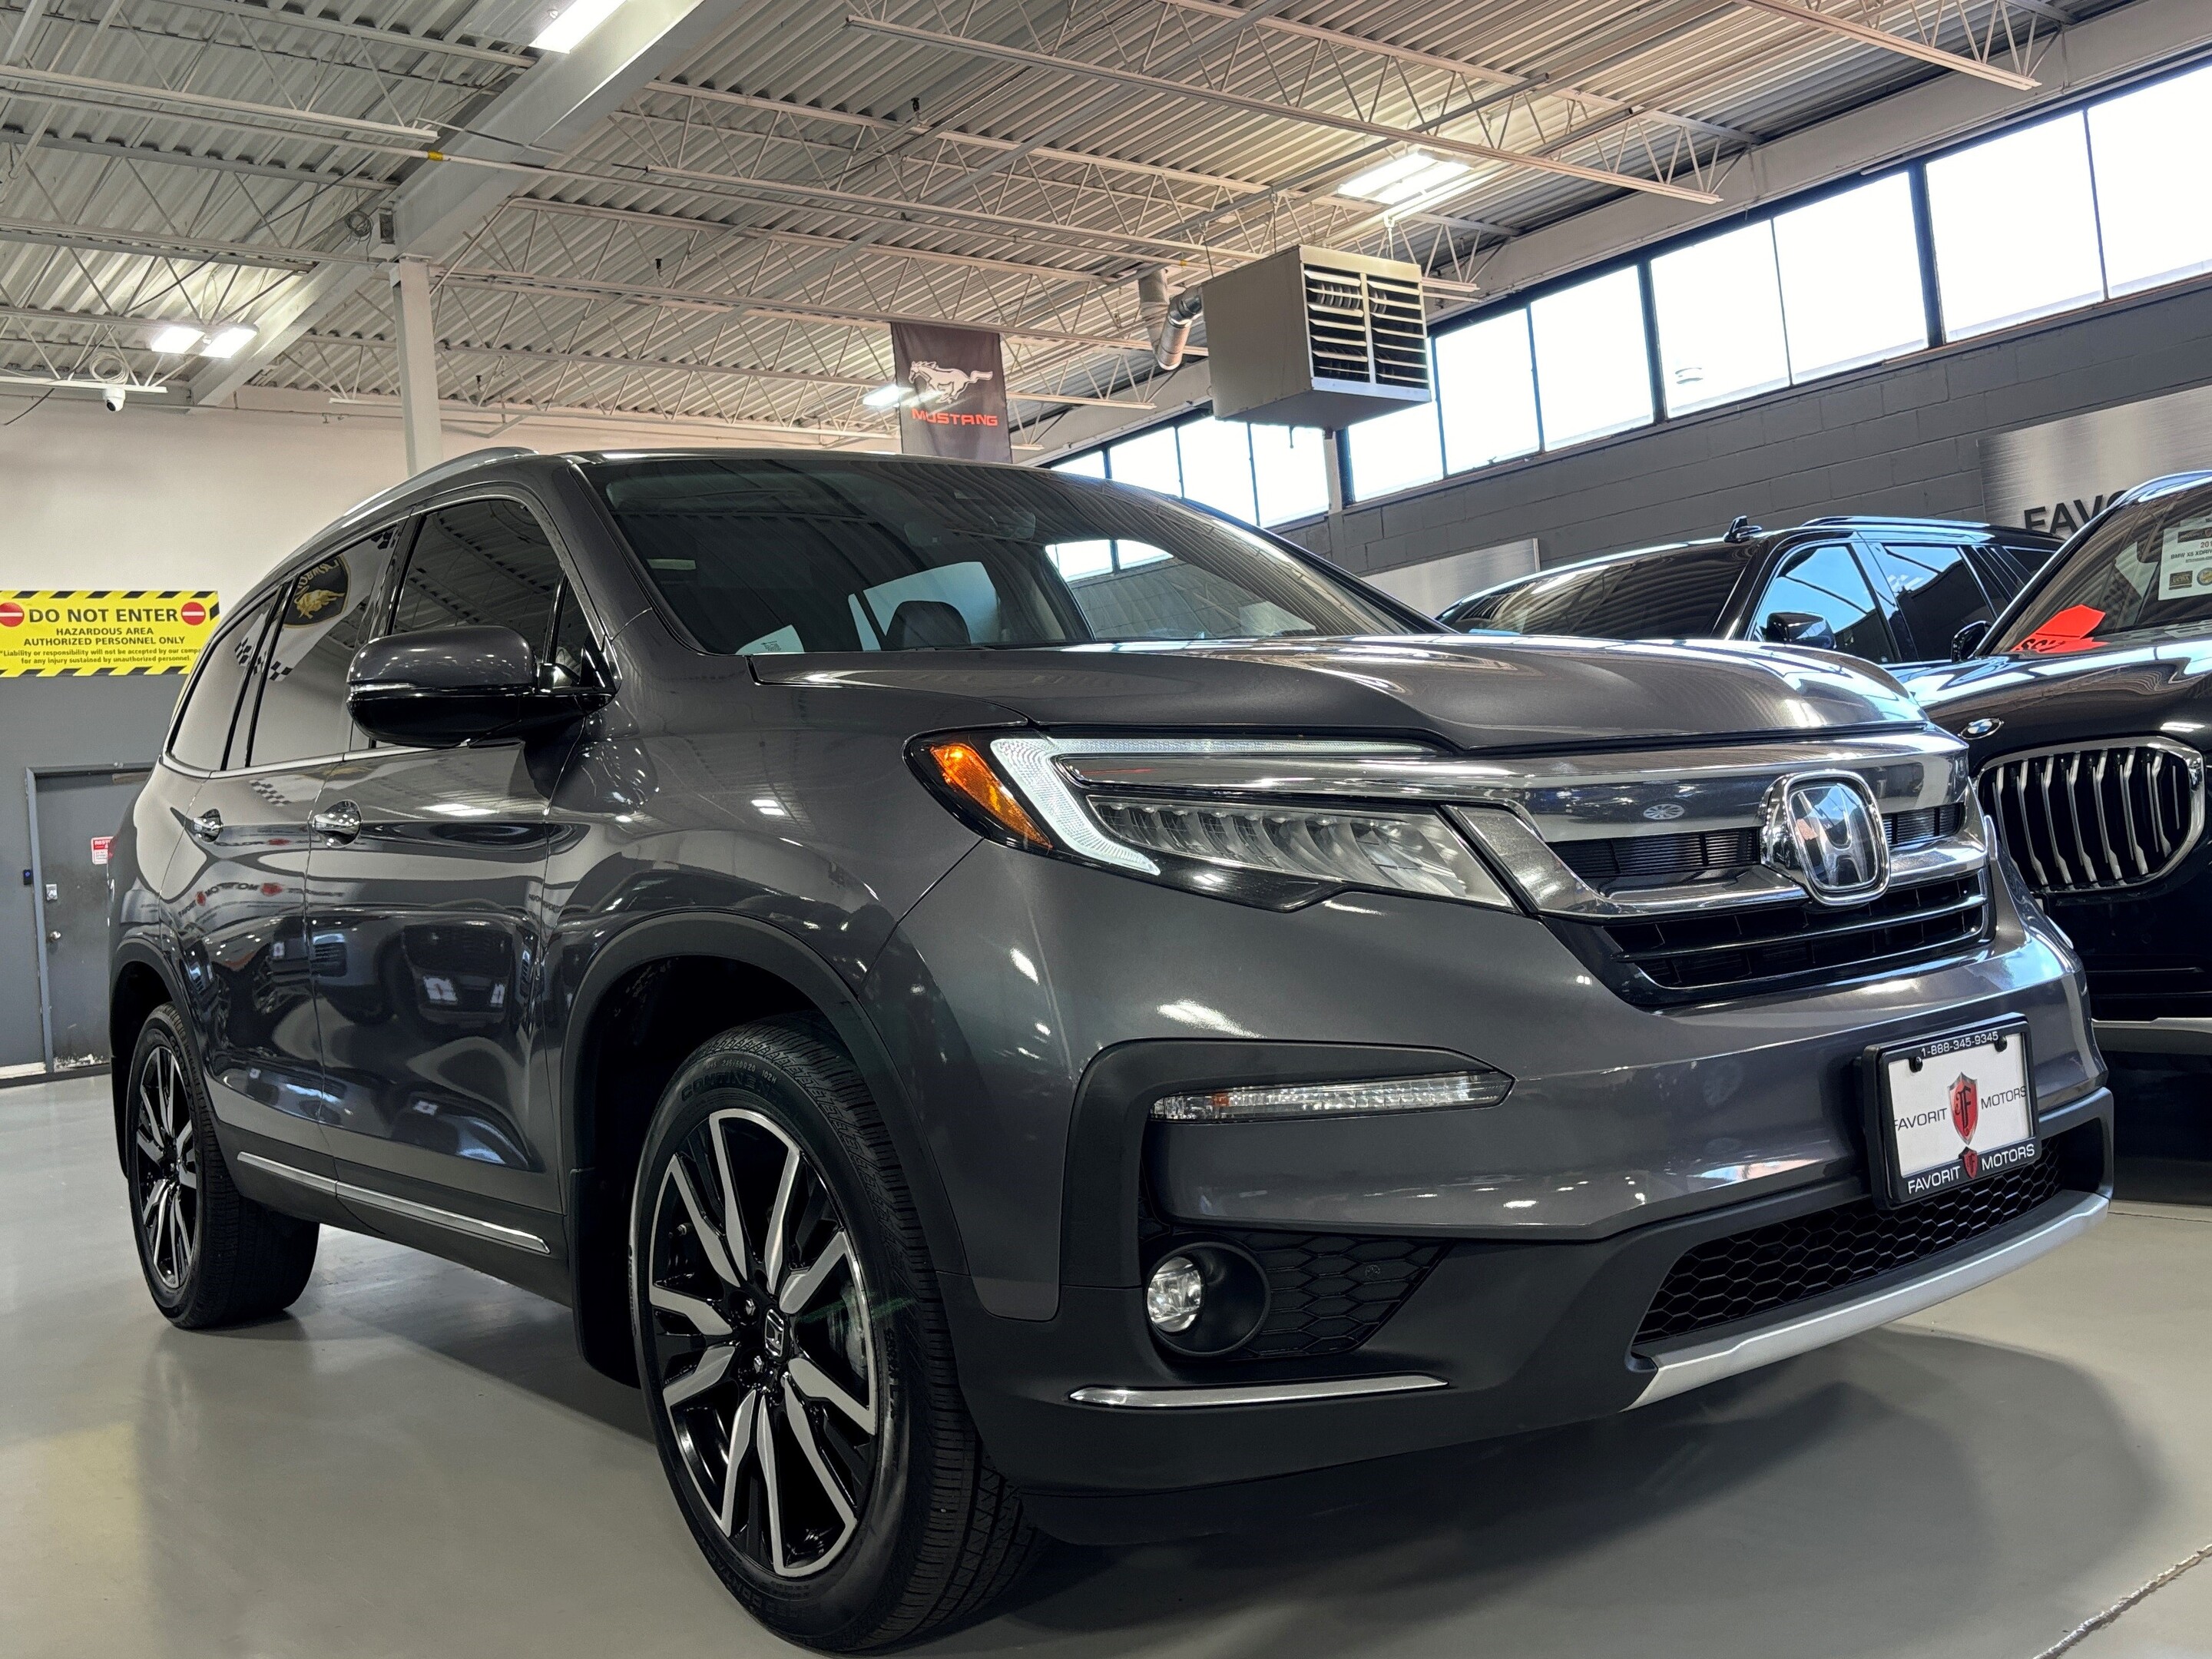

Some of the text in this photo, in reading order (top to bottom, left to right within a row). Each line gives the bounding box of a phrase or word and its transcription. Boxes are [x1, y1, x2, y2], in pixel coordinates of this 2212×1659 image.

[911, 408, 998, 426] MUSTANG
[28, 608, 179, 623] DO NOT ENTER
[56, 627, 154, 636] HAZARDOUS AREA
[23, 636, 185, 646] AUTHORIZED PERSONNEL ONLY
[1920, 1031, 1998, 1058] 1-888-345-9345
[1894, 1108, 1947, 1131] FAVORIT
[1981, 1085, 2027, 1110] MOTORS
[1908, 1166, 1960, 1194] FAVORIT
[1982, 1144, 2035, 1171] MOTORS
